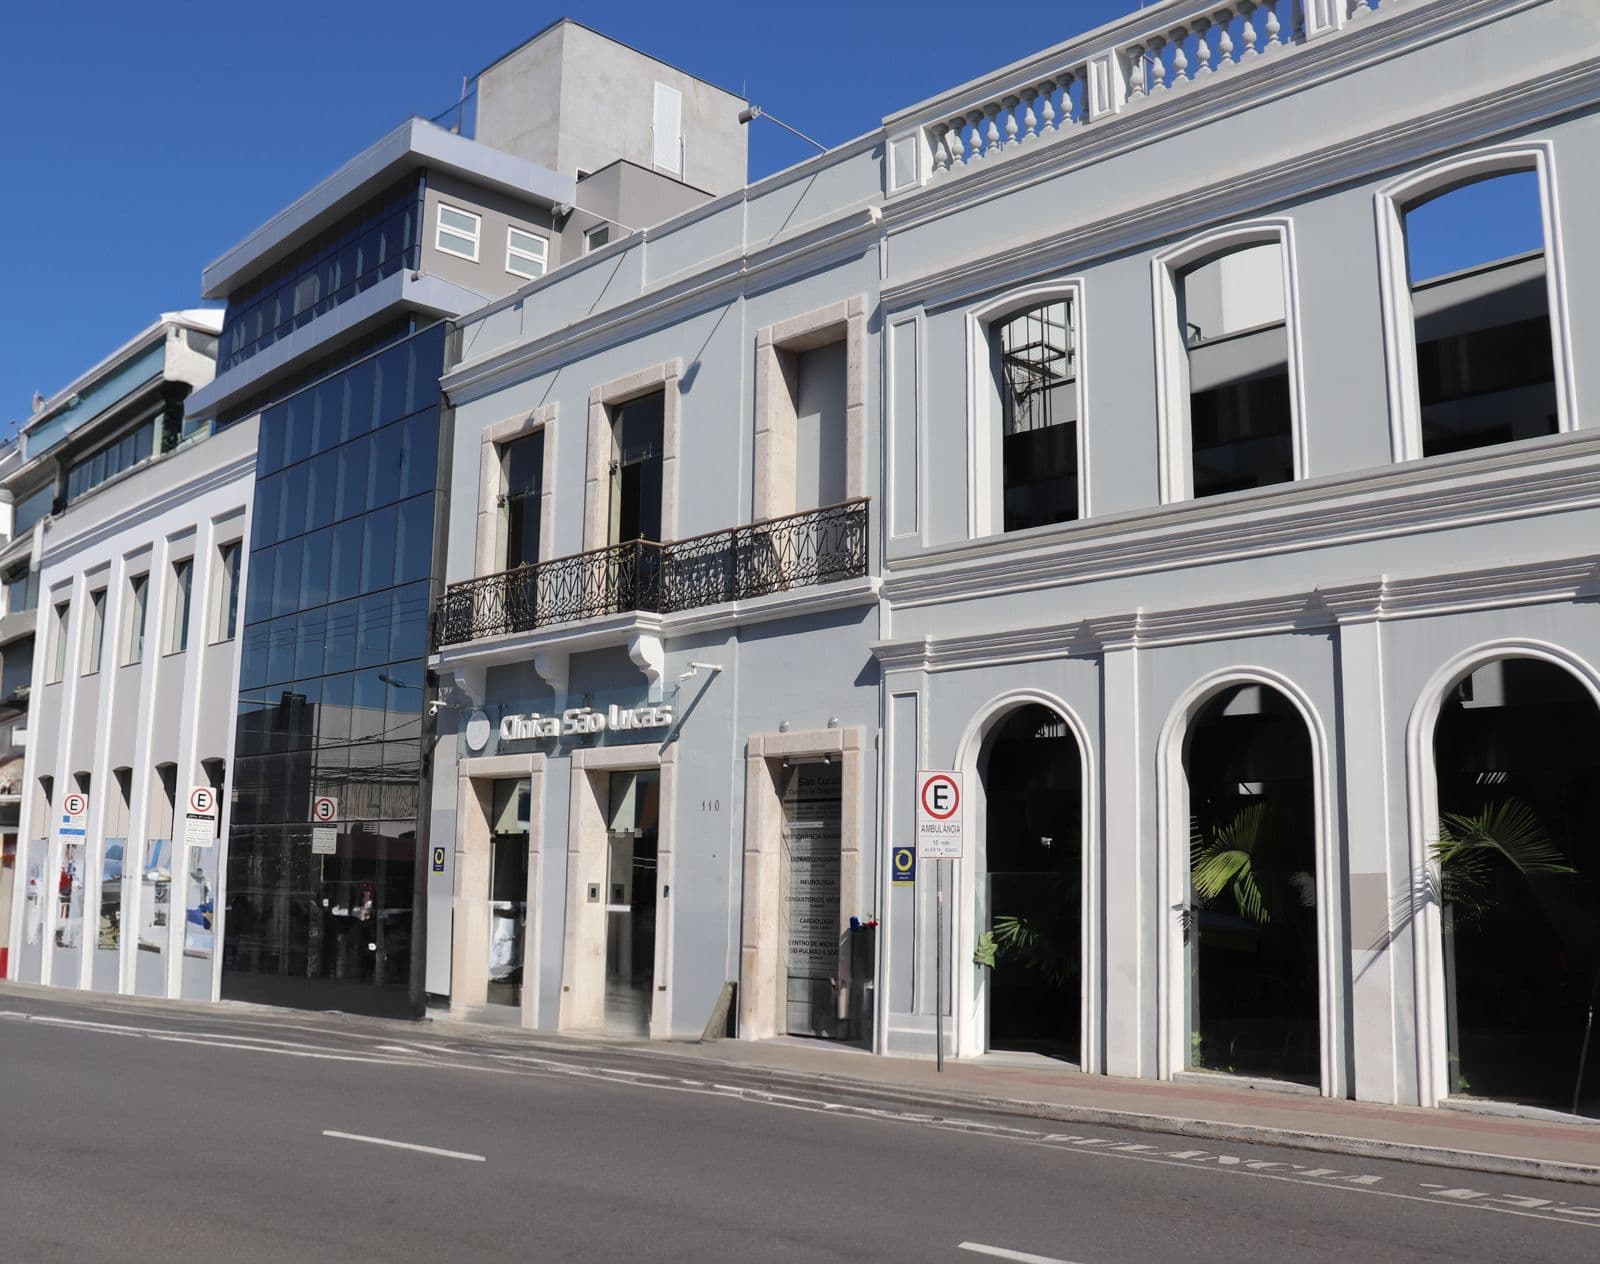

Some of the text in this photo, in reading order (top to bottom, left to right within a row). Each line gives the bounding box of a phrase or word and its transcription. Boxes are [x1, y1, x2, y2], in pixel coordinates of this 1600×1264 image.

[563, 707, 606, 735] São
[609, 704, 672, 731] Lucas
[197, 793, 207, 807] E
[934, 785, 948, 810] E
[70, 799, 79, 811] E
[702, 800, 720, 811] 110
[920, 823, 961, 834] AMBULÂNCIA
